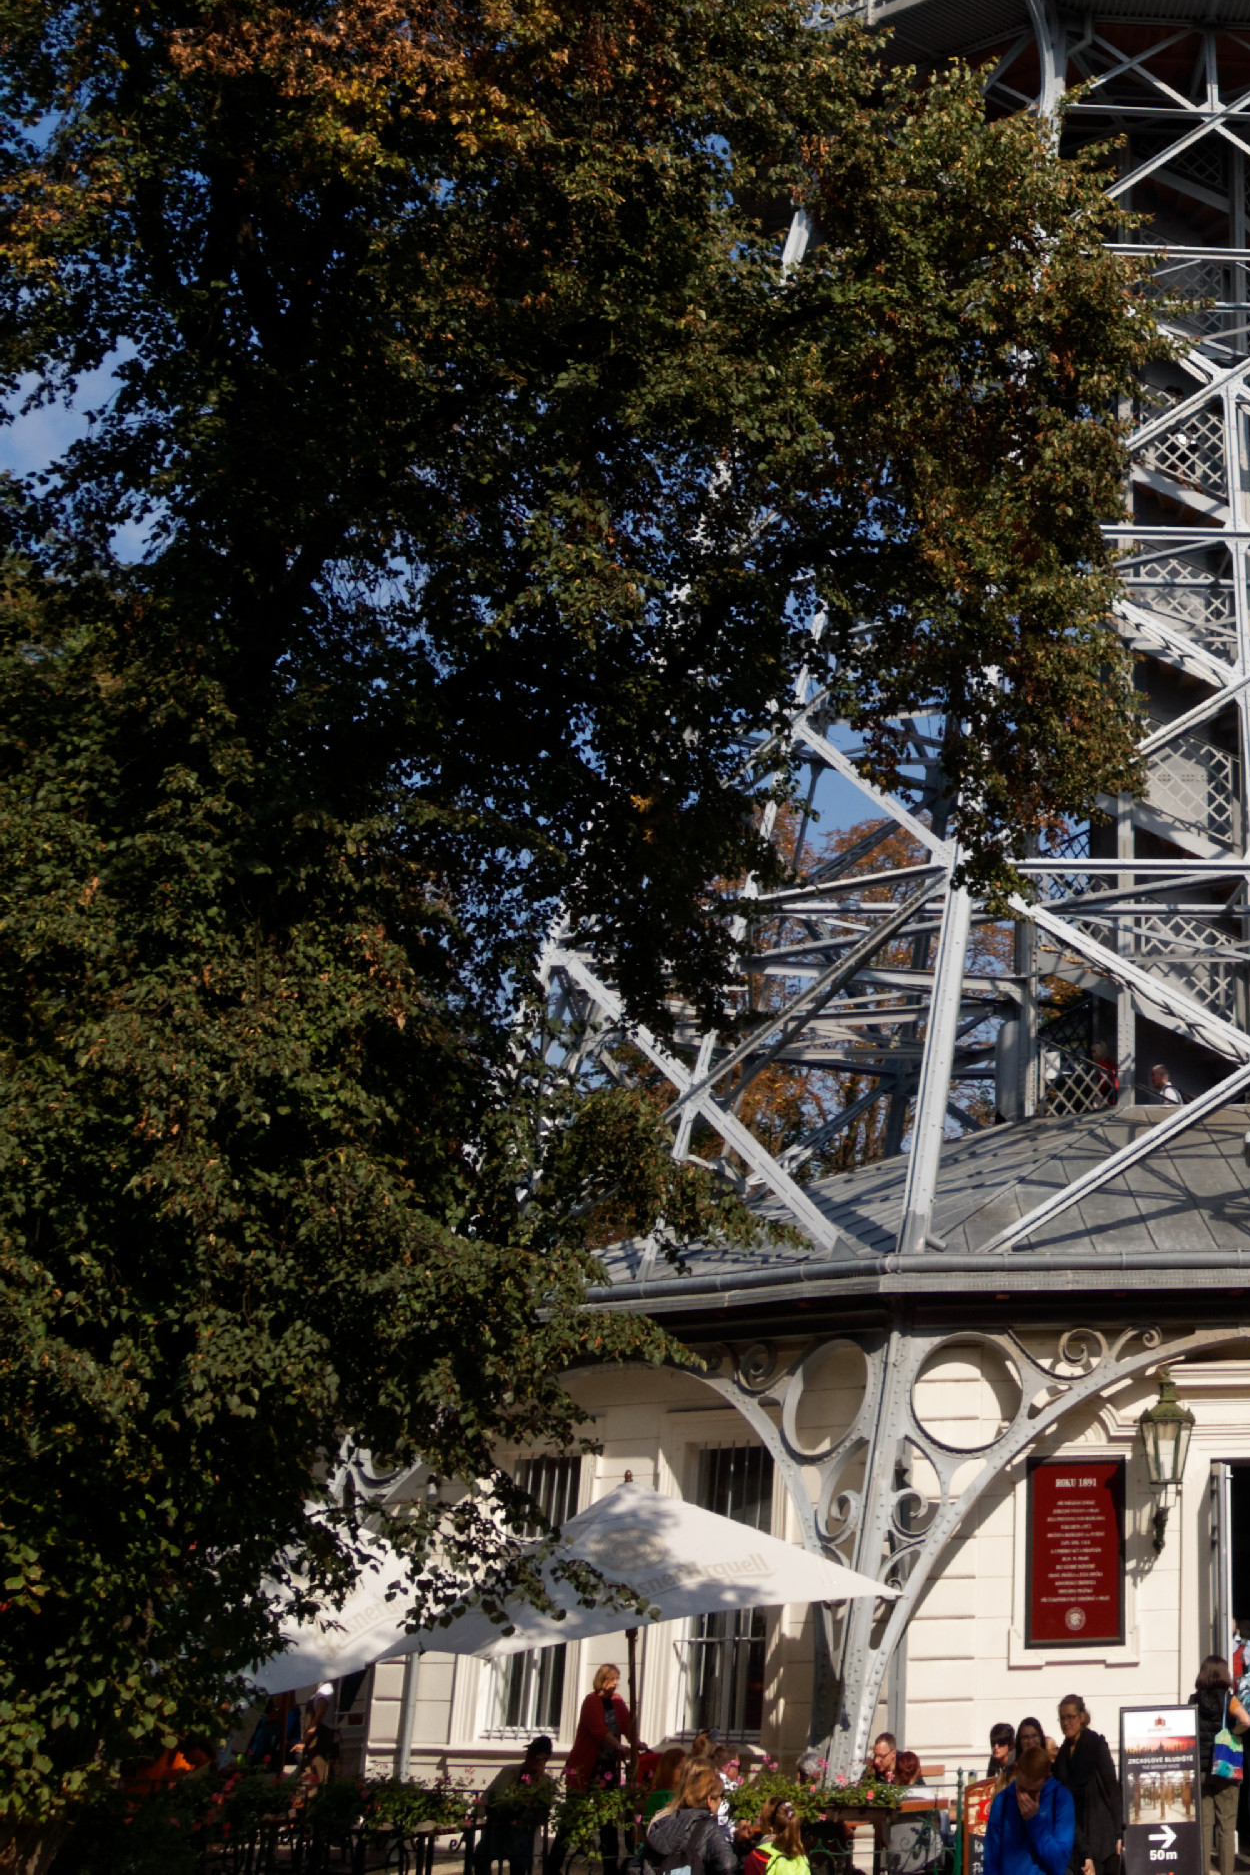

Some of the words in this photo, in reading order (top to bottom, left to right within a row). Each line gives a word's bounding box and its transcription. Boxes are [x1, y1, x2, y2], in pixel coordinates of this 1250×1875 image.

[1055, 1478, 1077, 1487] ROKU
[1078, 1477, 1097, 1487] 1891
[1149, 1850, 1179, 1861] 50m
